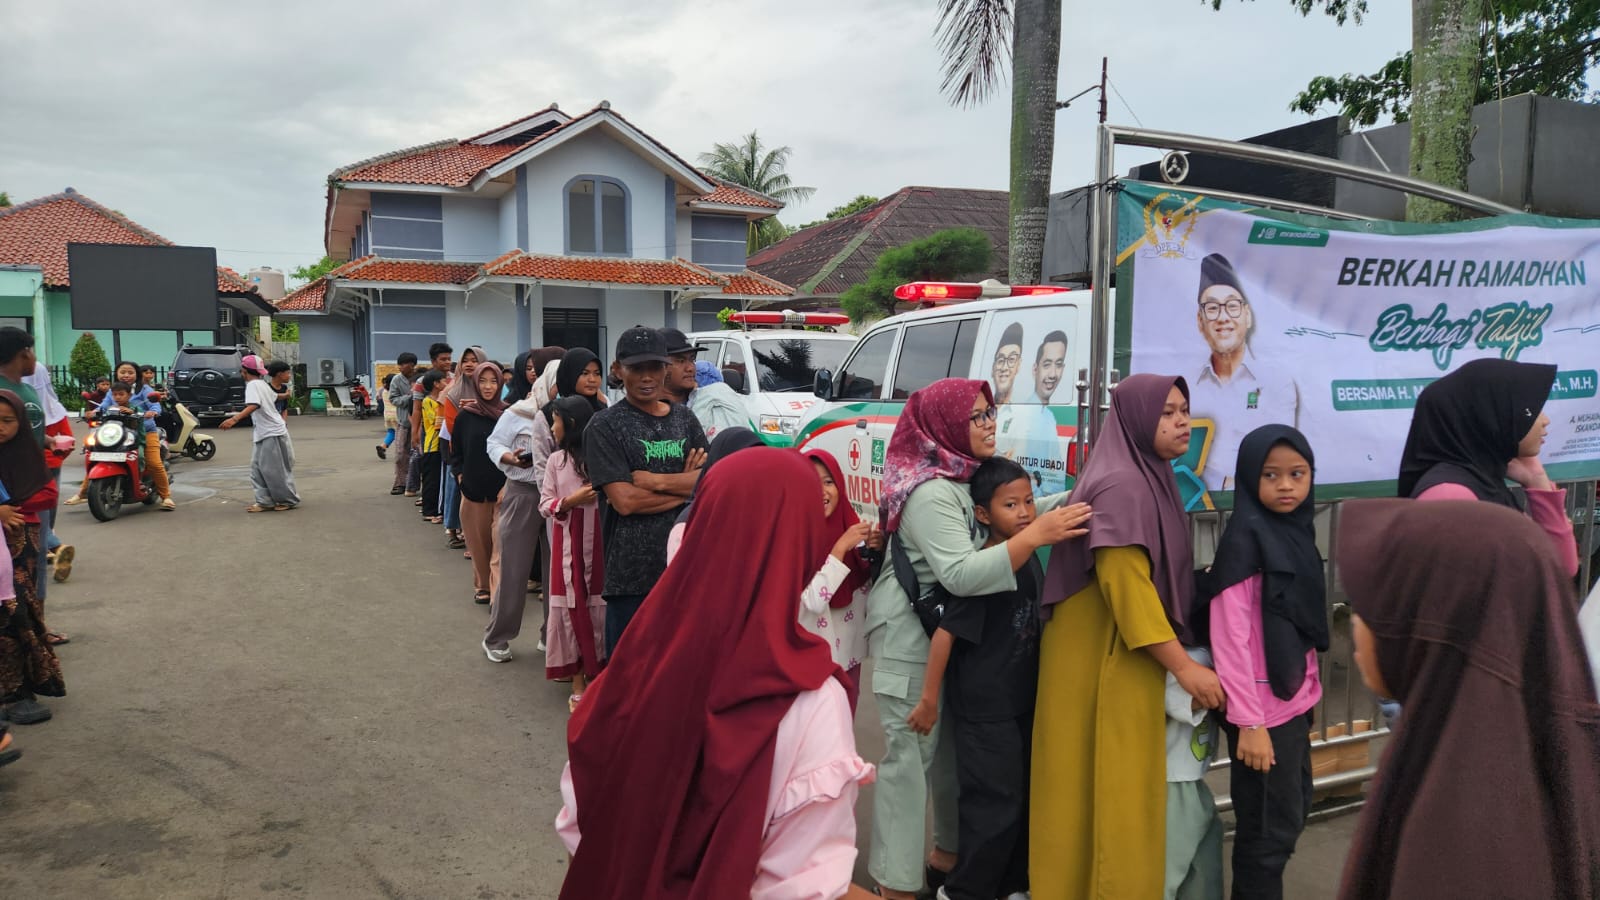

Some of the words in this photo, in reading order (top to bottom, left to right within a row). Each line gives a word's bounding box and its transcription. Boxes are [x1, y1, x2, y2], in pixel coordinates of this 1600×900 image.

[1337, 257, 1456, 287] BERKAH
[1457, 260, 1587, 287] RAMADHAN
[1371, 306, 1480, 368] Berbagi
[1477, 304, 1551, 361] Takjil
[1336, 386, 1396, 402] BERSAMA
[1398, 386, 1411, 400] H.
[1569, 376, 1594, 391] M.H.
[1040, 457, 1065, 471] UBADI
